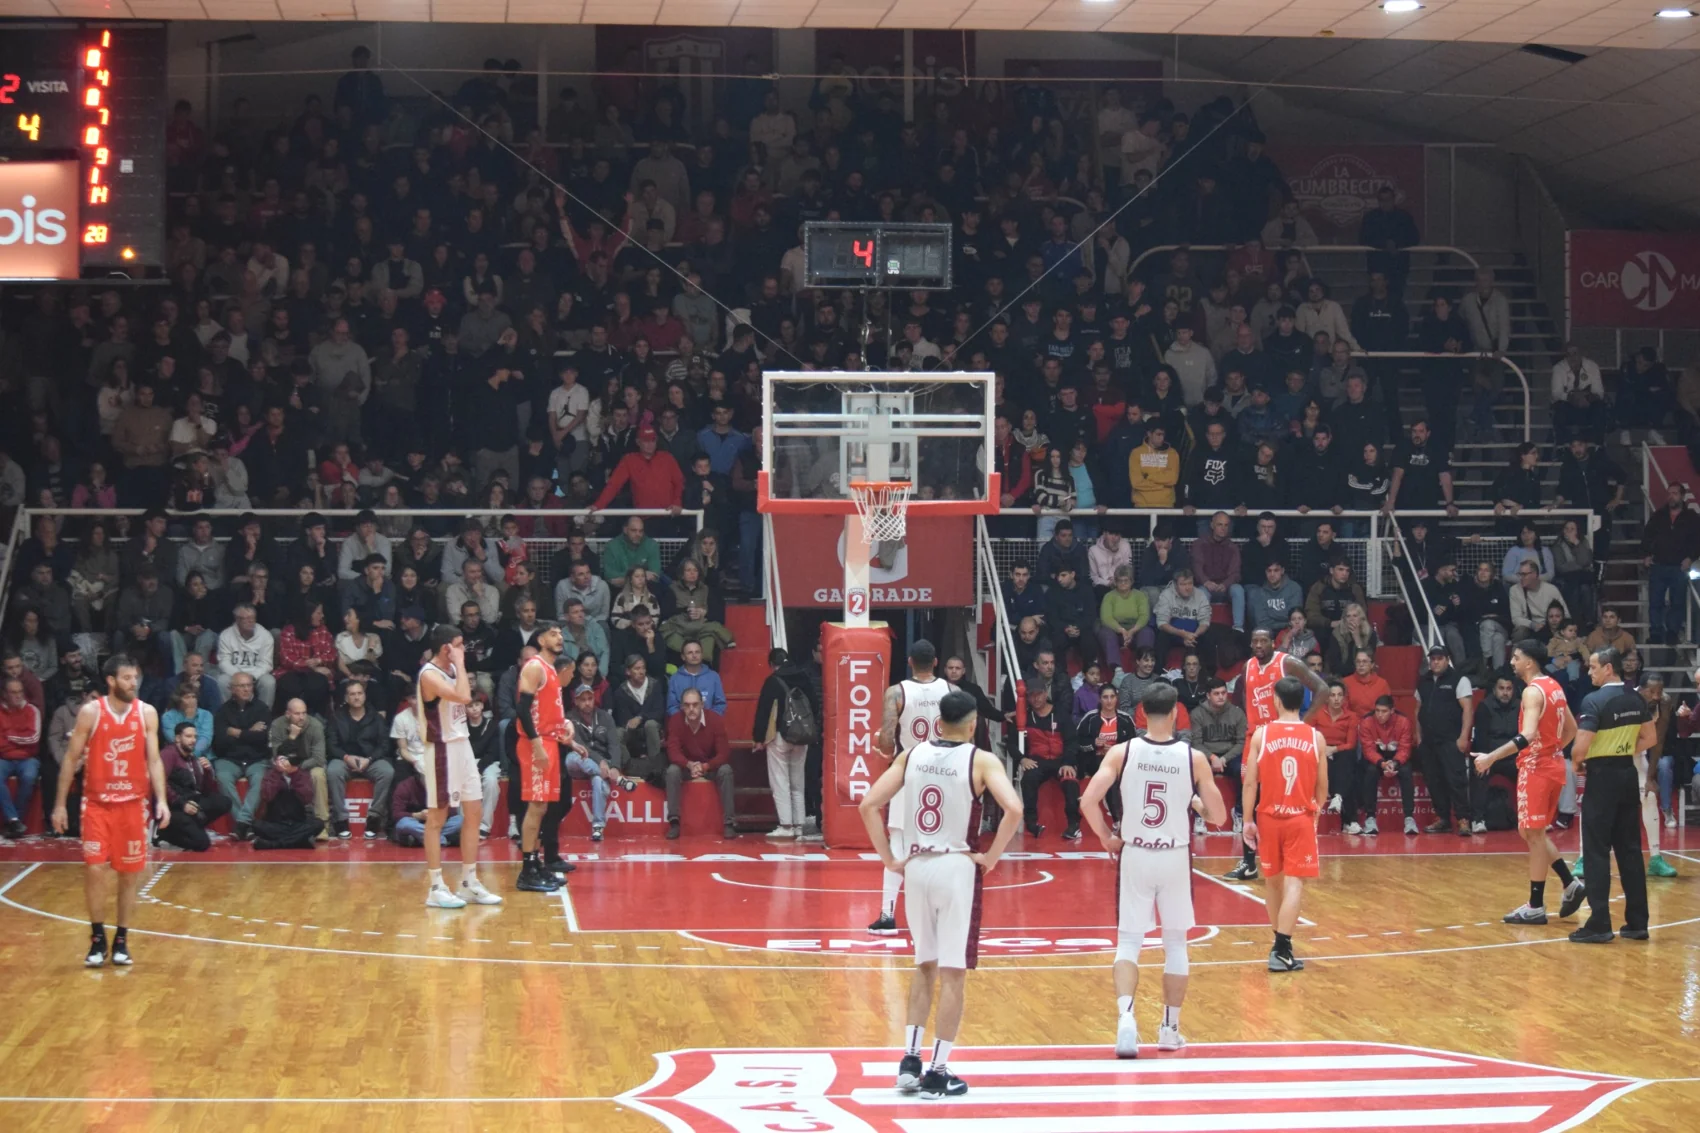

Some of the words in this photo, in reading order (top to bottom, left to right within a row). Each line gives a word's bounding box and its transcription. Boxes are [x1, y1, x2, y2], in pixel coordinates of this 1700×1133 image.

[27, 81, 69, 93] VISITA
[18, 113, 40, 141] 4
[1333, 165, 1350, 178] LA
[852, 239, 875, 269] 4
[1204, 459, 1227, 471] FOX
[813, 587, 933, 603] GARADE
[851, 594, 863, 613] 2
[113, 759, 129, 777] 12
[915, 763, 958, 777] NOBLEGA
[1137, 762, 1181, 775] REINAUDI
[1281, 755, 1299, 796] 9
[914, 783, 944, 836] 8
[1141, 780, 1168, 829] 5
[127, 839, 142, 856] 12
